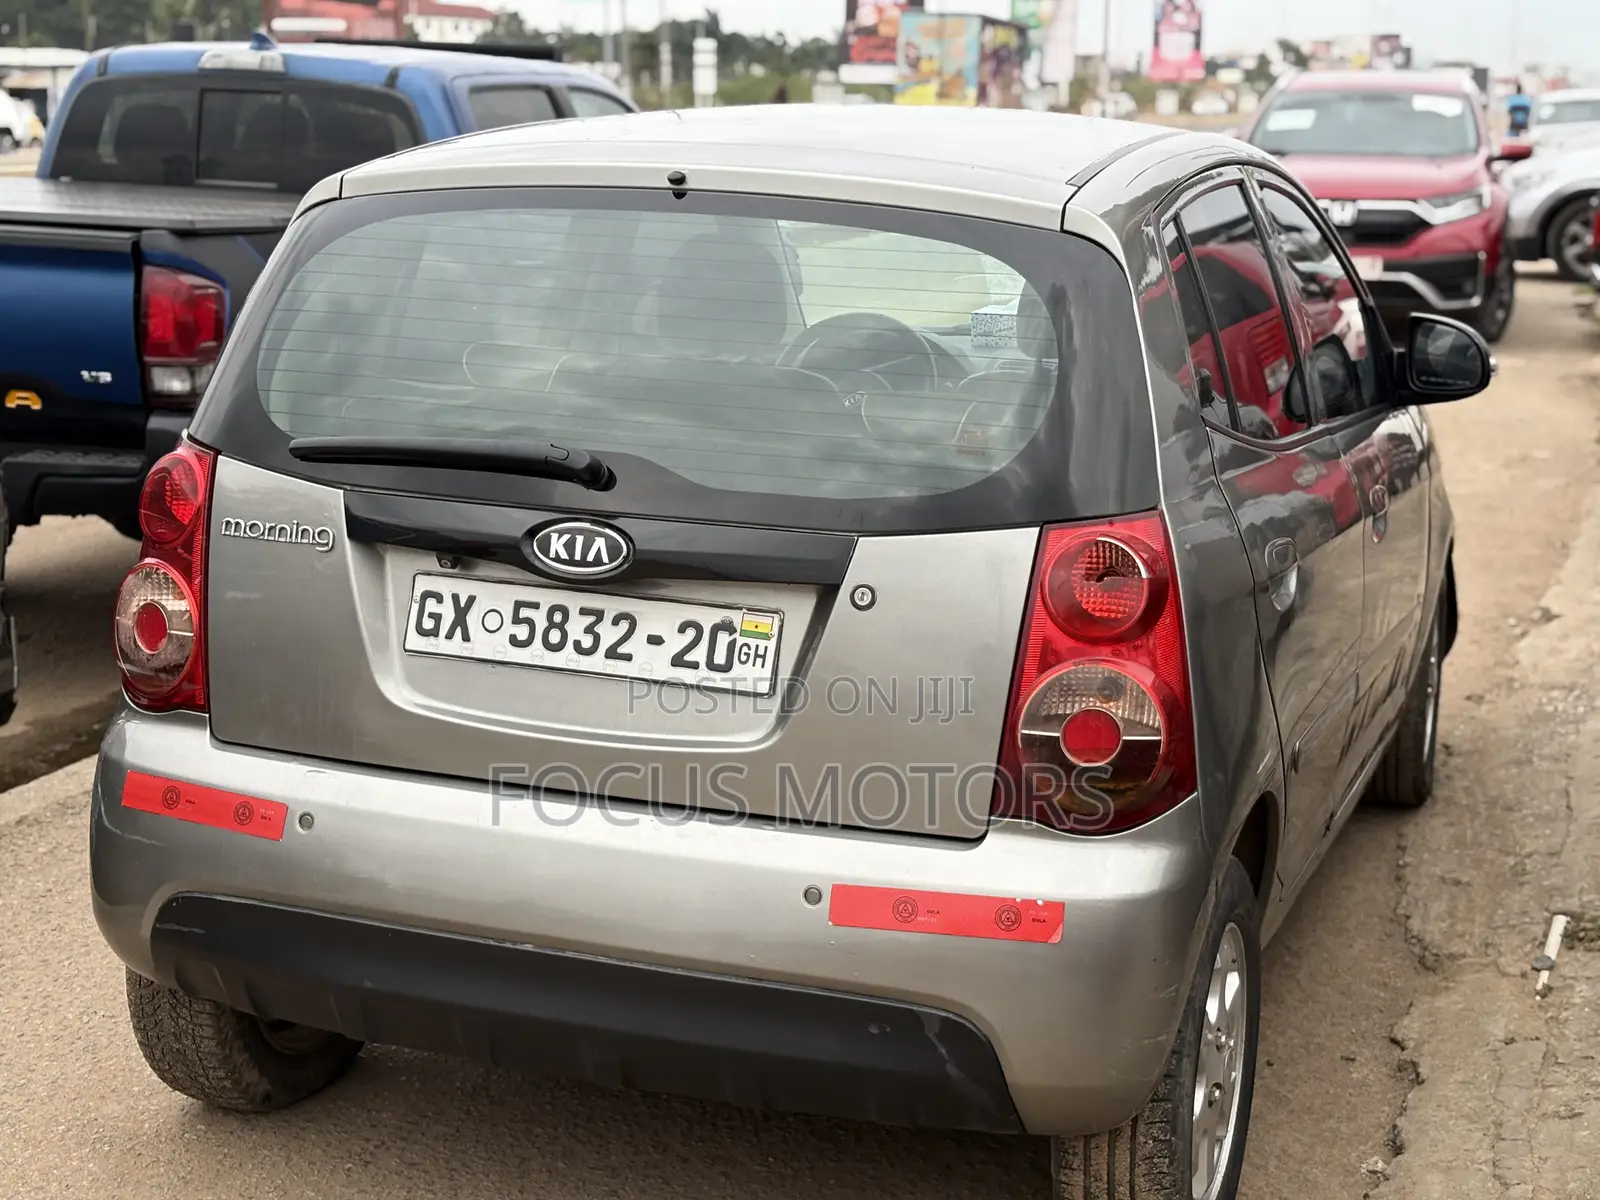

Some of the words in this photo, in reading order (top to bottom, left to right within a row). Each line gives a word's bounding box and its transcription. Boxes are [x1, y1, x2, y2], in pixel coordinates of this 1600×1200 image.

[221, 517, 334, 552] morning
[549, 532, 610, 564] KIA
[415, 589, 477, 642] GX
[737, 642, 768, 669] GH
